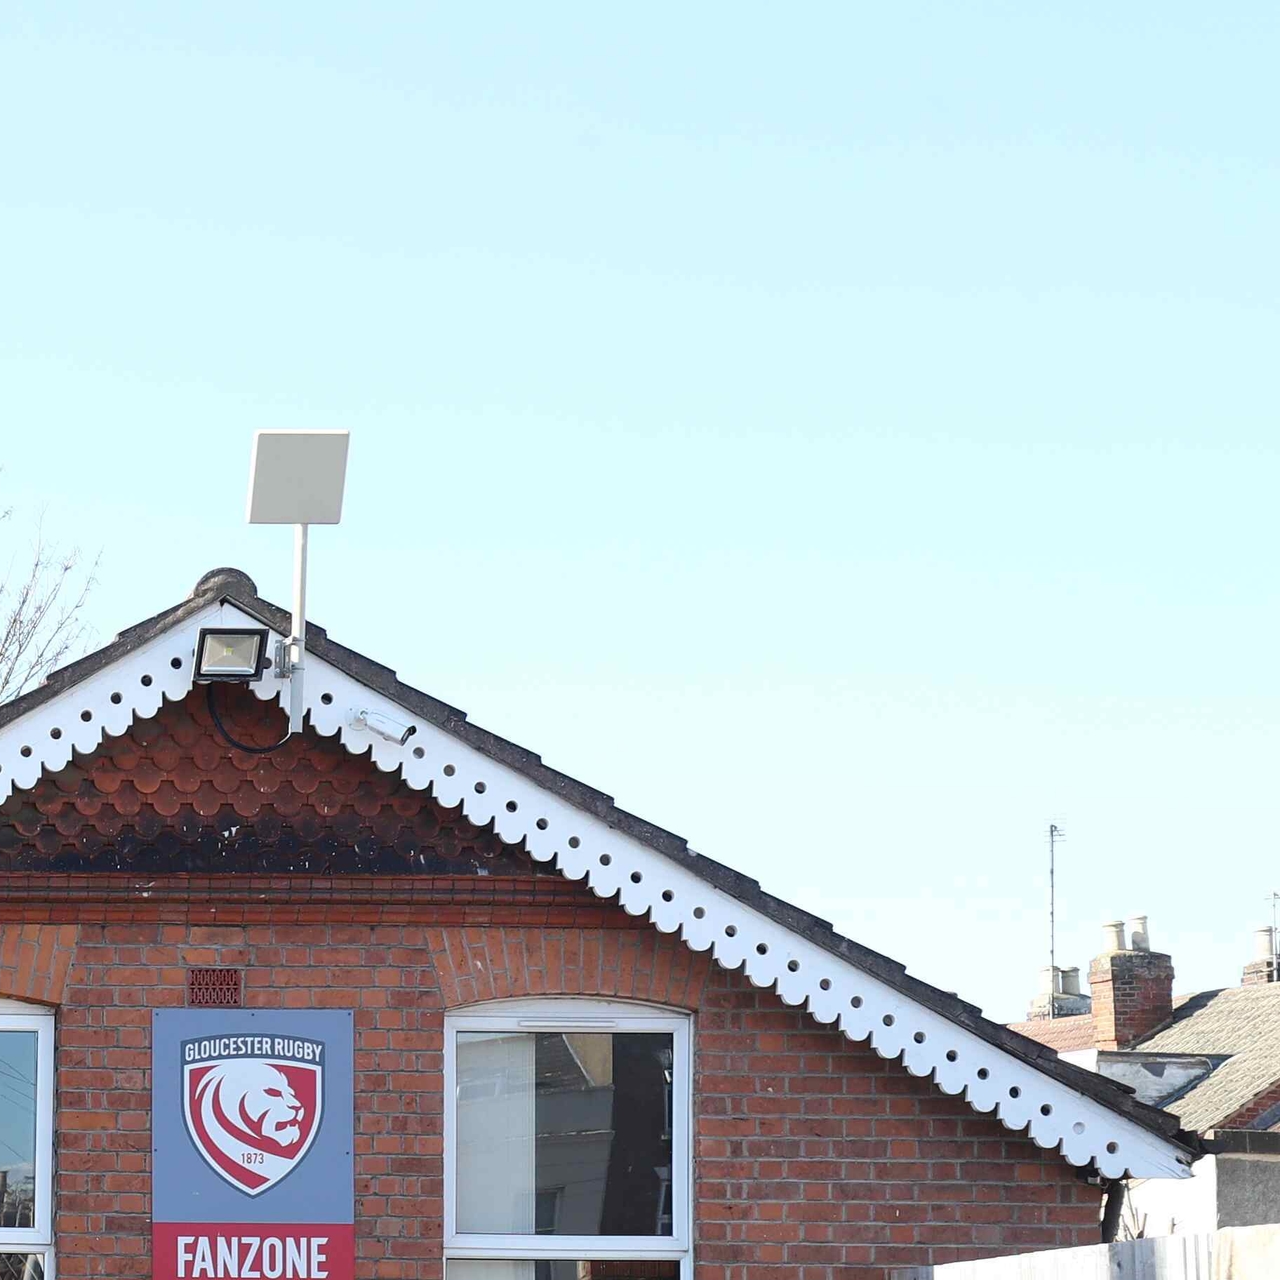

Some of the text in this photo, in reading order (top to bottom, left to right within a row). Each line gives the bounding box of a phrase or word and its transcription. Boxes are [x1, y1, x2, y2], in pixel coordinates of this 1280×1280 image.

[185, 1037, 322, 1062] GLOUCESTER RUGBY
[241, 1152, 264, 1165] 1873
[176, 1236, 329, 1279] FANZONE
